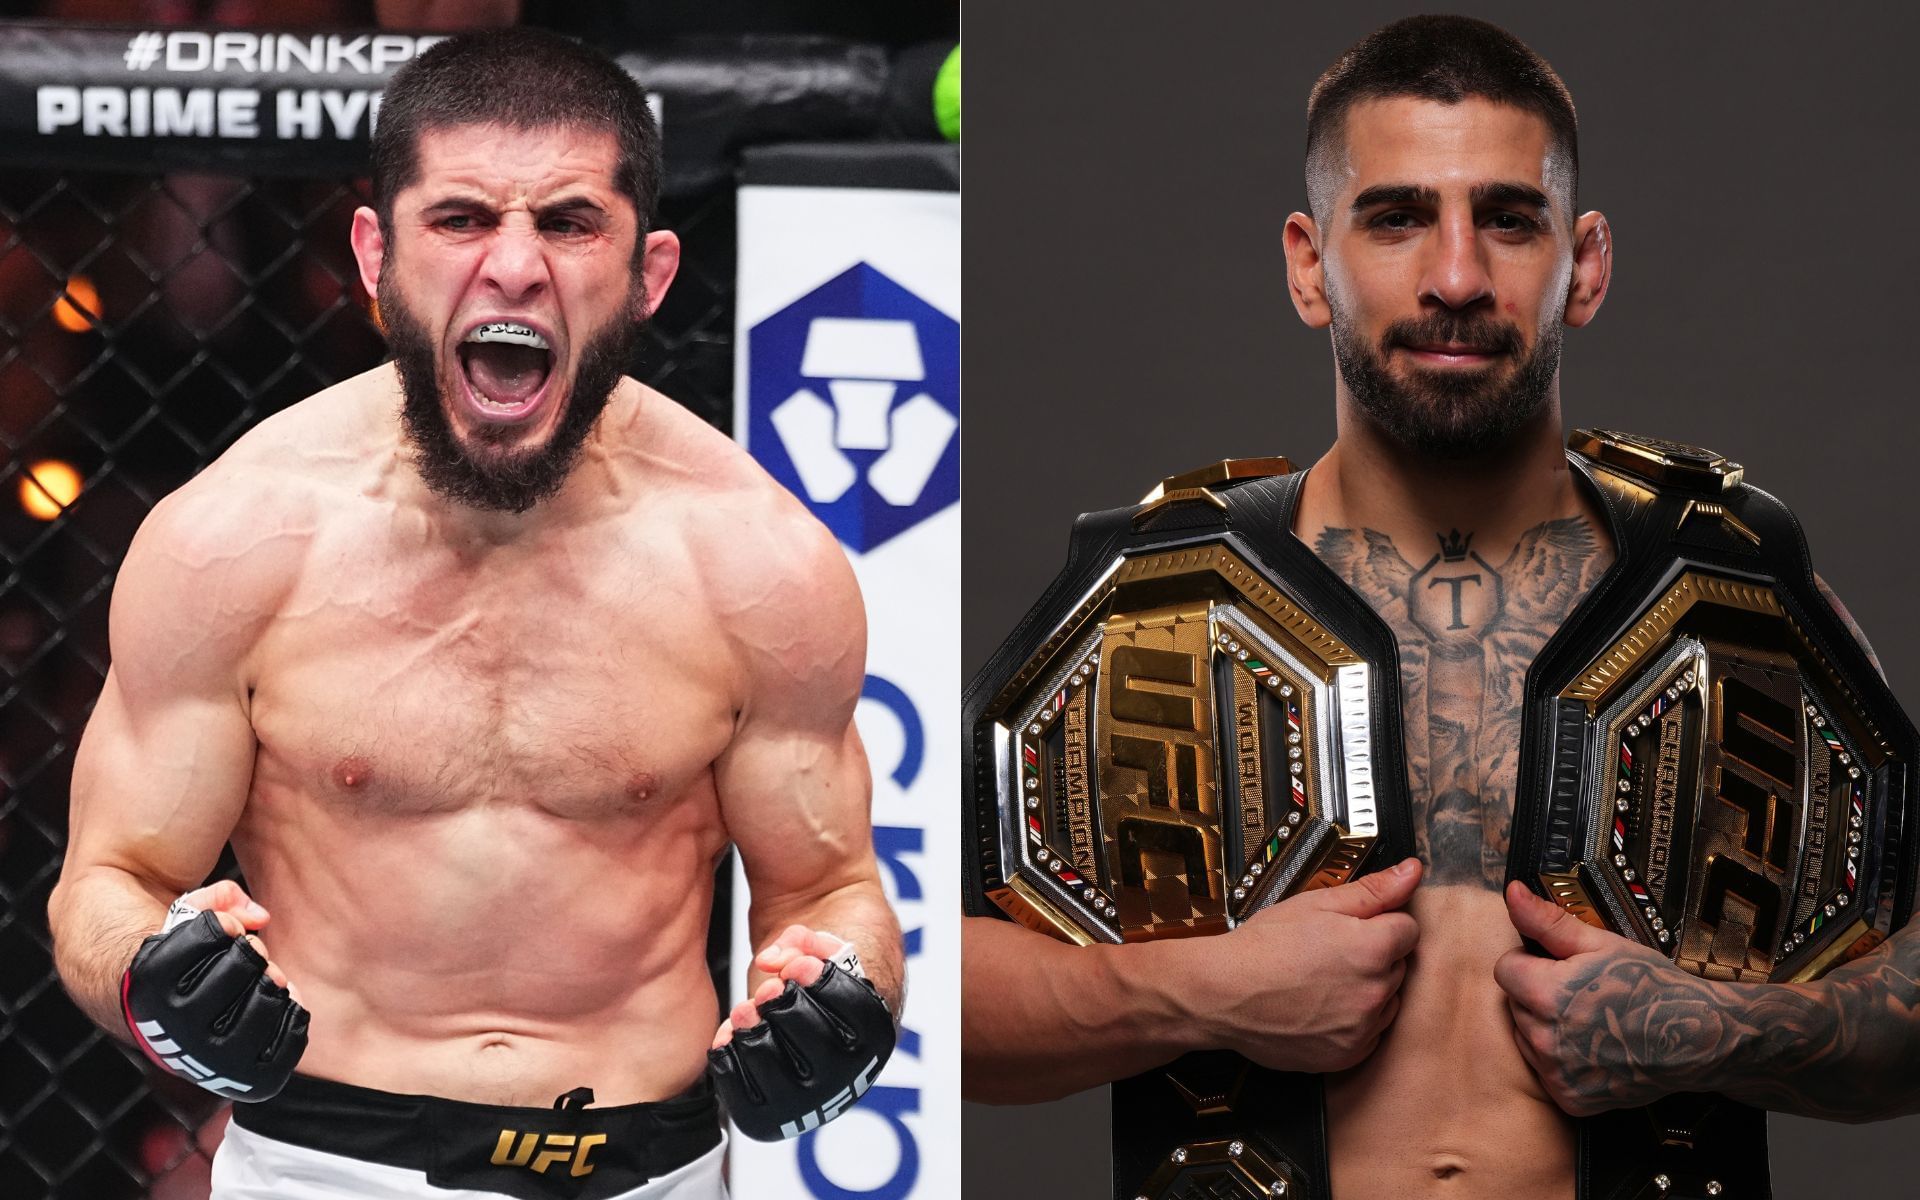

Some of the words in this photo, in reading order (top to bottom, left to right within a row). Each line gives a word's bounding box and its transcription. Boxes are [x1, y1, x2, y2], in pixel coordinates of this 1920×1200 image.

[36, 86, 261, 138] PRIME
[1428, 574, 1482, 631] T
[1067, 706, 1093, 870] CHAMPION
[1110, 645, 1212, 899] UFC
[1238, 702, 1260, 827] WORLD
[1650, 720, 1678, 889] CHAMPION
[1700, 676, 1796, 957] UFC
[1803, 772, 1829, 898] WORLD
[136, 1020, 253, 1098] UFC
[780, 1055, 879, 1140] UFC
[490, 1129, 607, 1177] UFC
